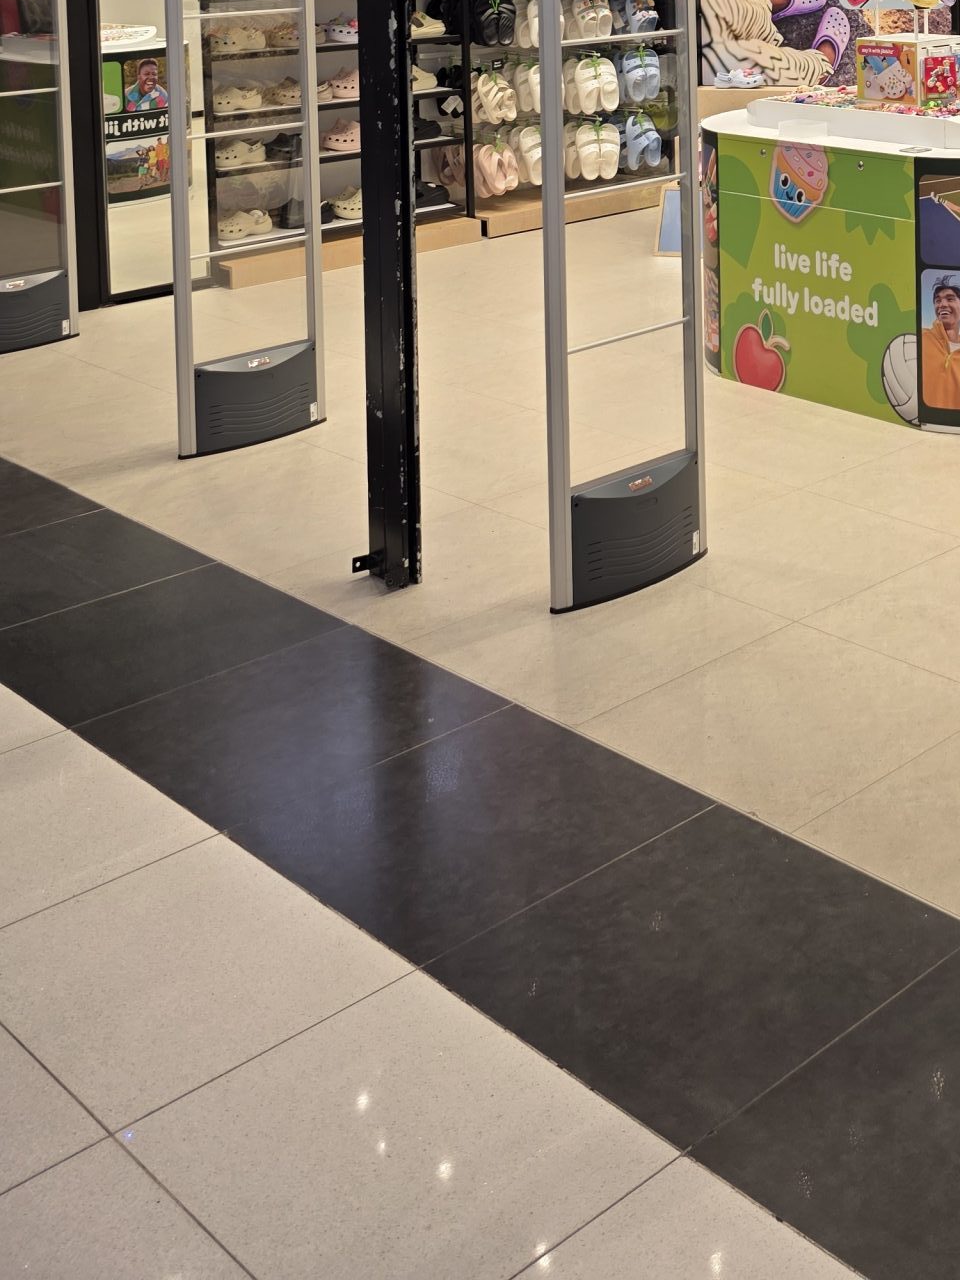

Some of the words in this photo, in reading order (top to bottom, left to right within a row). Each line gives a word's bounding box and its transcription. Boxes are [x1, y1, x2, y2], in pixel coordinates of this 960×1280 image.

[774, 242, 811, 274] live
[815, 250, 853, 282] life
[752, 277, 799, 315] fully
[804, 286, 878, 327] loaded
